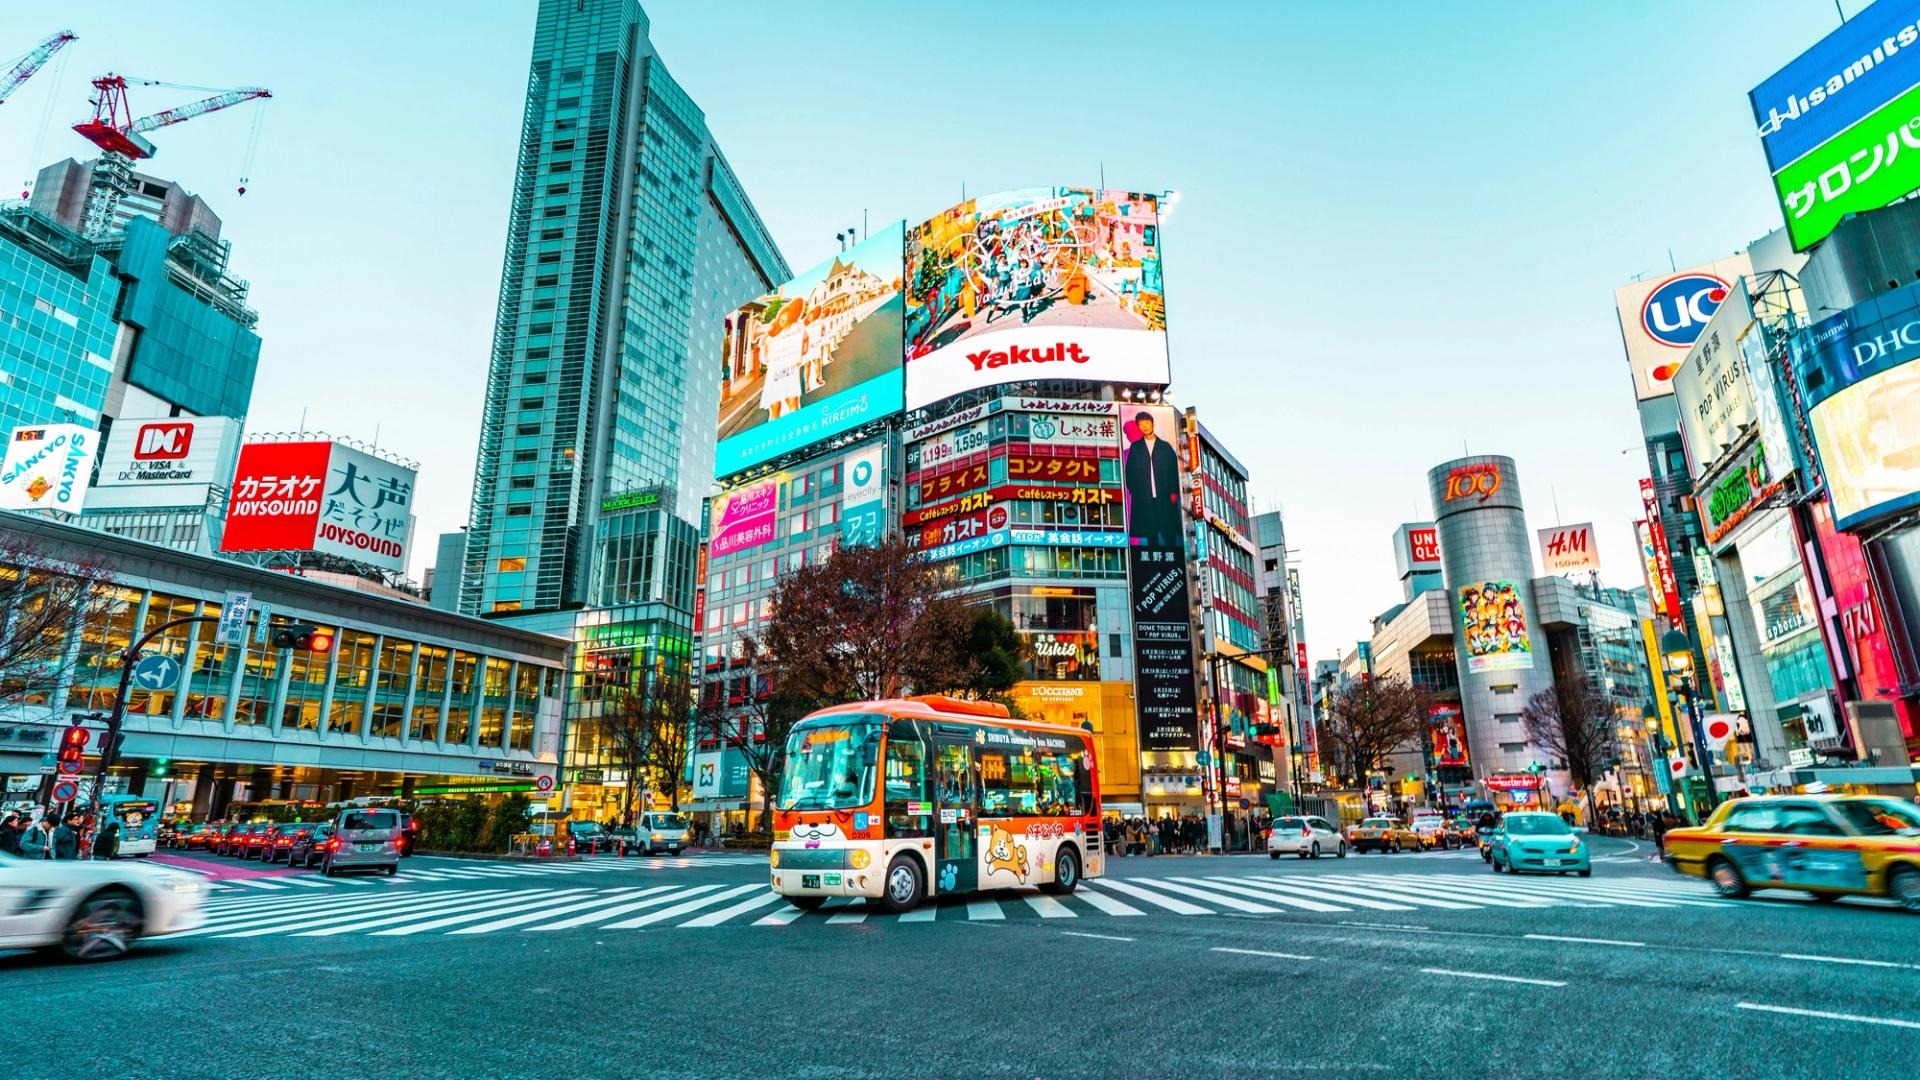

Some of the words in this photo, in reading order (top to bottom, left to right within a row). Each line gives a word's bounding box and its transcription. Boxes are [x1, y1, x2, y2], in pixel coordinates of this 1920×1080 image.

[1757, 19, 1920, 137] Hisamits
[1811, 318, 1849, 346] Channel
[966, 343, 1089, 371] Yakult
[821, 398, 868, 427] KIREIMO
[1020, 399, 1113, 412] しゃぶしゃぶバイキング
[1060, 420, 1114, 437] しゃぶ葉
[140, 428, 185, 454] DC
[2, 434, 66, 484] SANKYO
[130, 461, 146, 470] DC
[149, 461, 171, 470] VISA
[907, 451, 919, 464] 9F
[1009, 458, 1096, 477] コンタクト
[57, 433, 88, 503] SANKYO
[118, 471, 136, 480] DC
[136, 470, 192, 480] MasterCard
[237, 475, 320, 499] カラオケ
[328, 462, 411, 509] 大声
[922, 465, 986, 498] プライス
[1443, 471, 1500, 503] 109
[960, 491, 993, 513] ガスト
[1072, 488, 1113, 504] ガスト
[233, 500, 318, 516] JOYSOUND
[740, 498, 769, 515] クリニック
[319, 522, 402, 558] JOYSOUND
[720, 523, 771, 550] 品川美容外科
[943, 517, 983, 543] ガスト
[1048, 532, 1125, 545] 英会話イーオン
[907, 534, 920, 548] 7F
[930, 537, 989, 560] 英会話イーオン
[1547, 528, 1587, 556] H&M
[1140, 551, 1174, 561] 星野源
[1555, 560, 1579, 568] 150m
[228, 595, 247, 640] 渋谷駅前
[582, 638, 617, 649] MARK
[1032, 686, 1084, 696] L'OCCITANE
[988, 733, 1010, 744] SHIBUYA
[1259, 759, 1275, 778] LUSH
[1025, 821, 1064, 840] ハチ公バス
